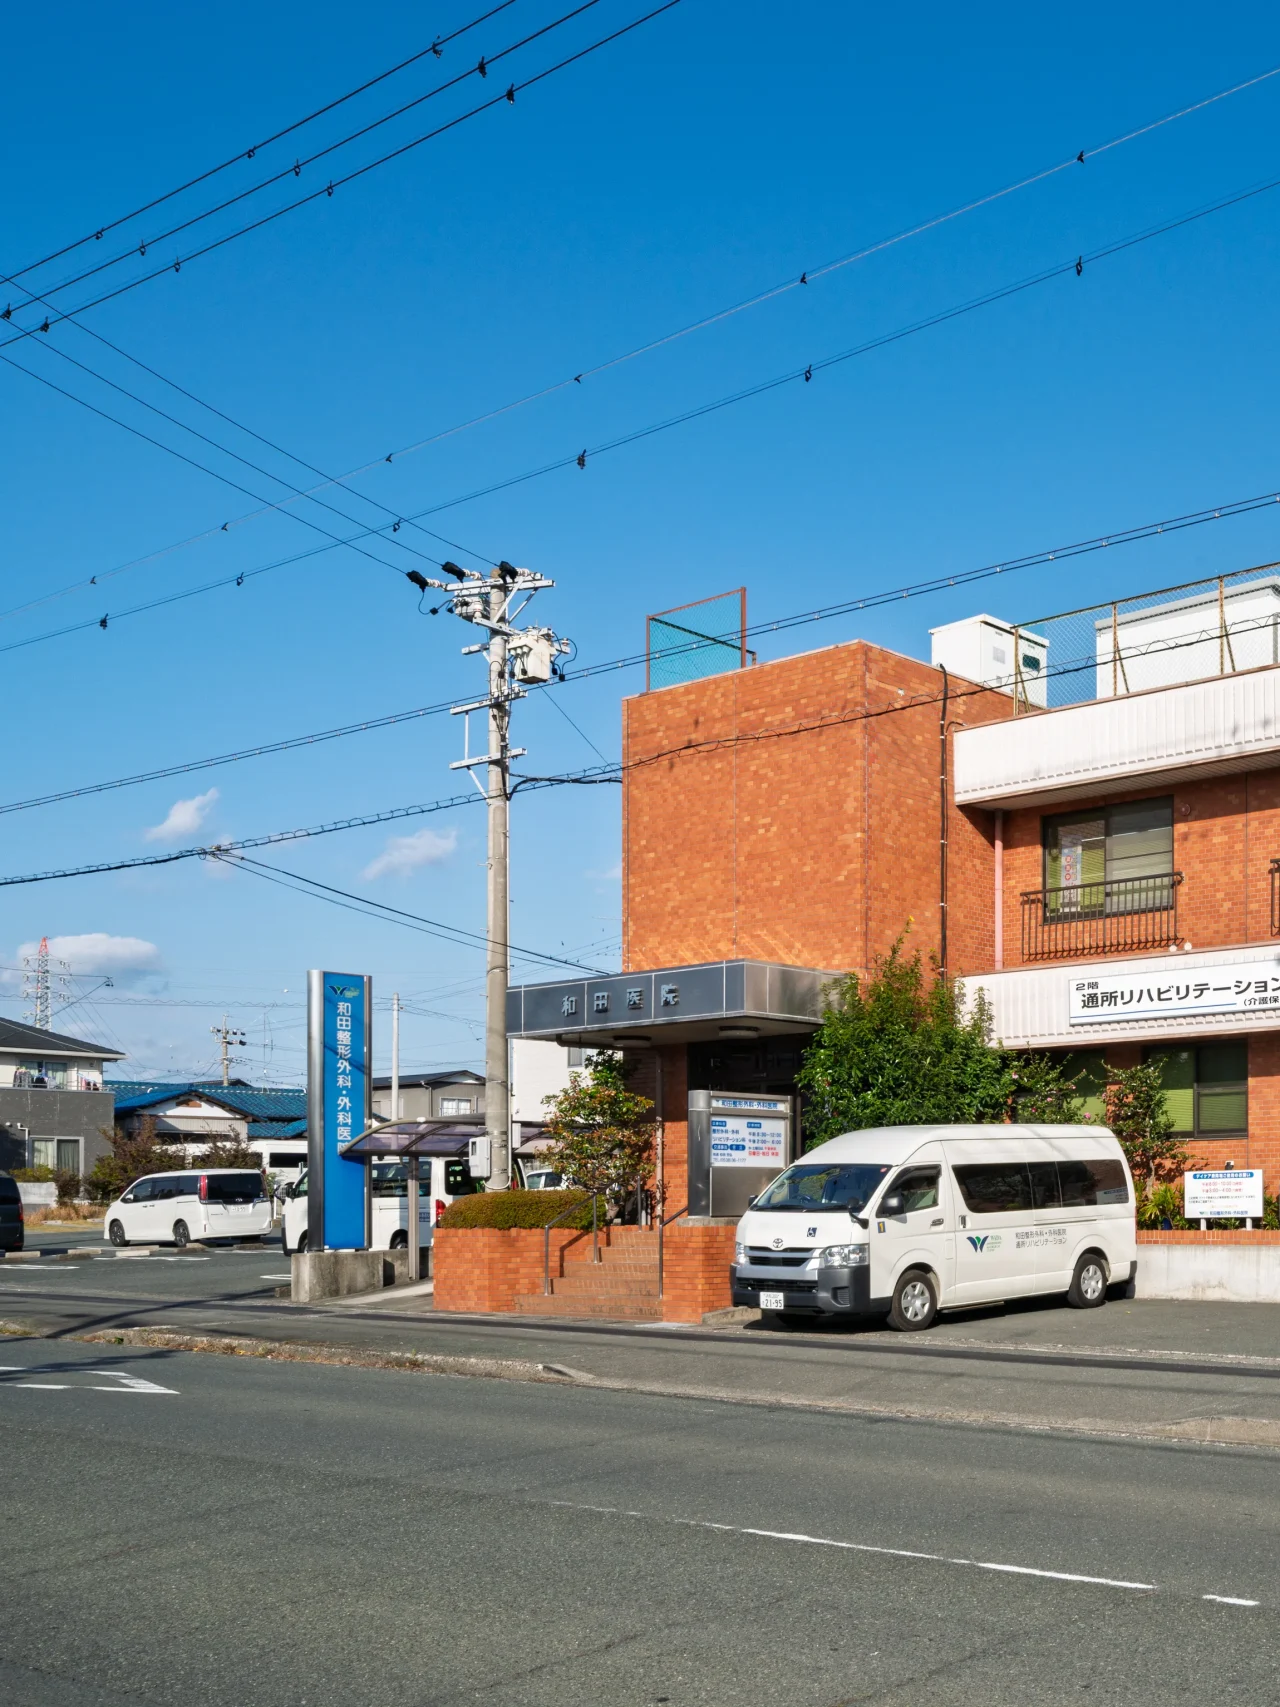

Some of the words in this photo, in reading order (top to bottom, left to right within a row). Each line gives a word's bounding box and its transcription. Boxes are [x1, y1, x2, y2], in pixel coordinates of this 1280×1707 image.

[1075, 981, 1099, 991] 2階
[561, 983, 679, 1017] 和田医院
